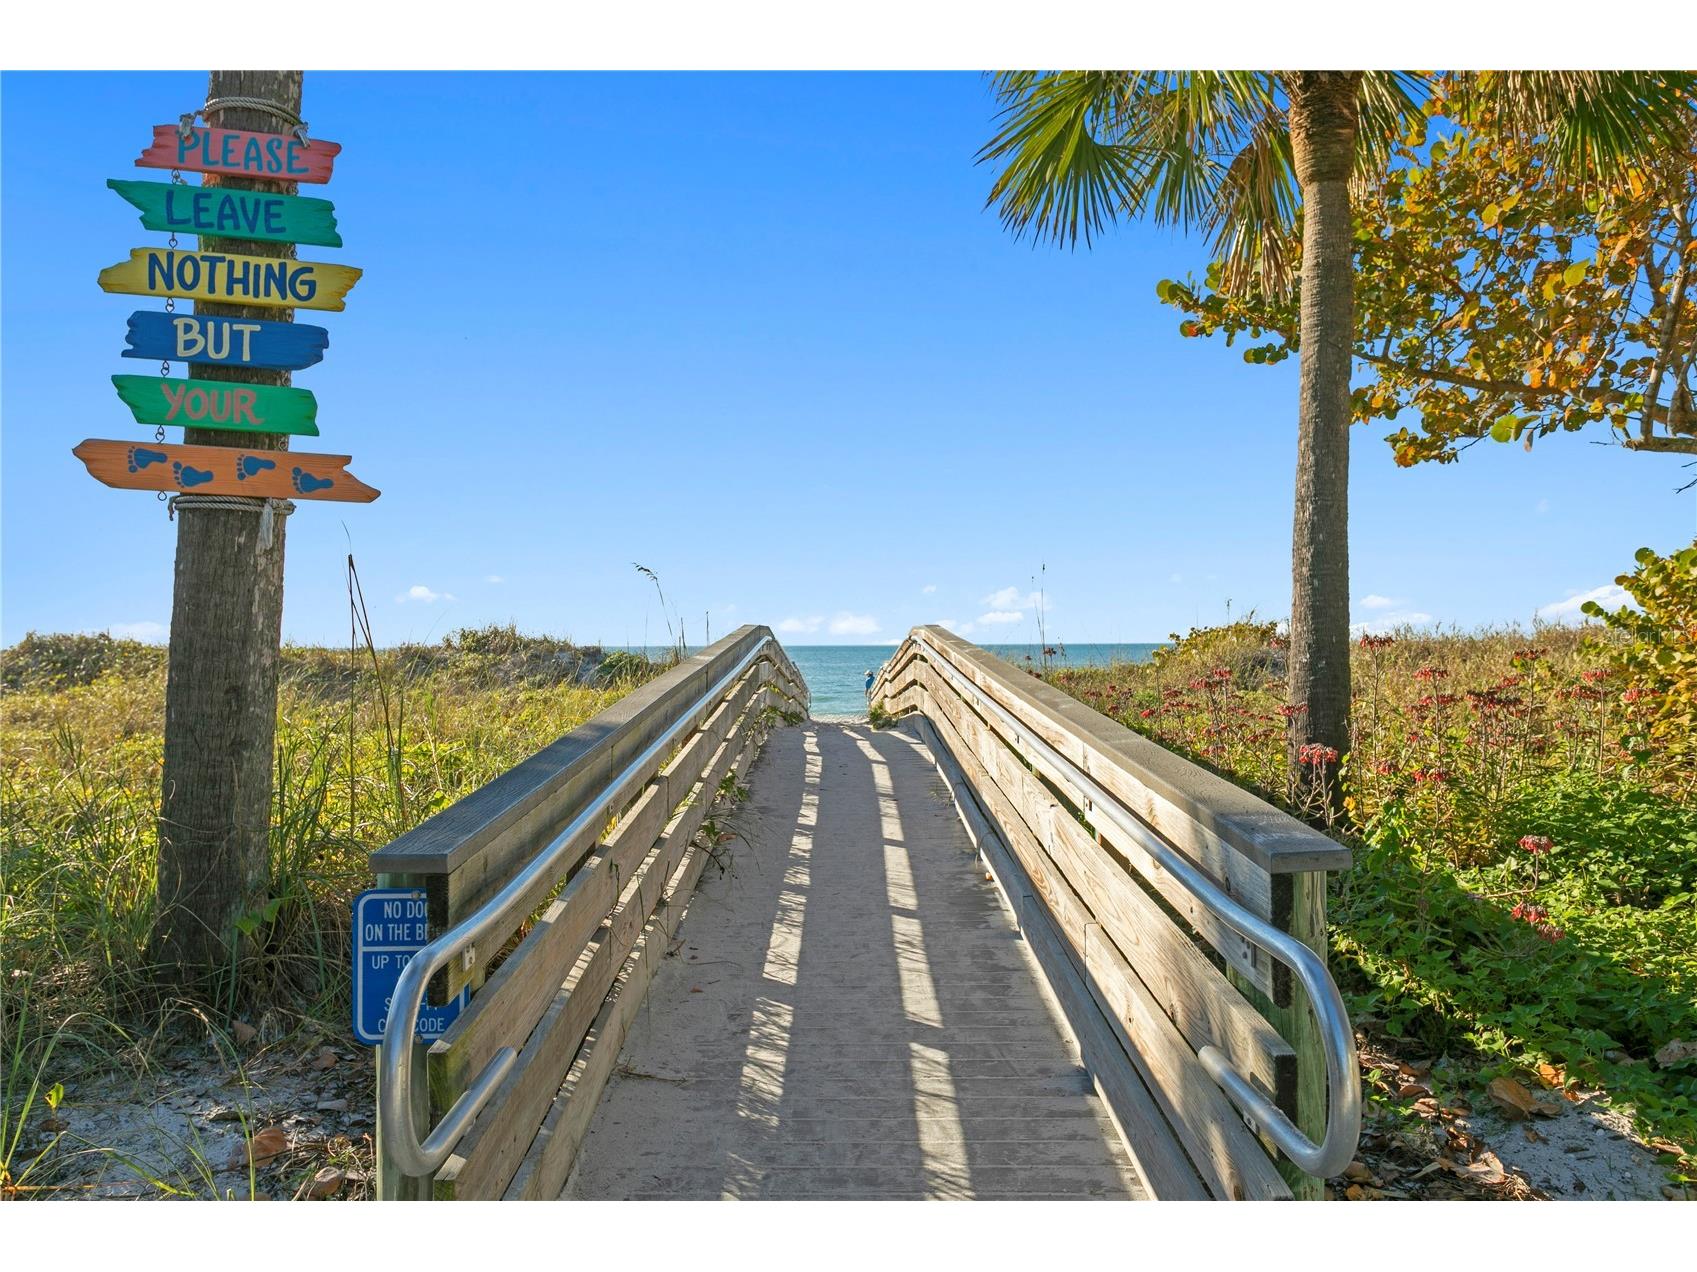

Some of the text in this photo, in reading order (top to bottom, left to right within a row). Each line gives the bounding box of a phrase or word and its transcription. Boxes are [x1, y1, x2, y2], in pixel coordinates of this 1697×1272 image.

[177, 131, 309, 174] PLEASE
[166, 190, 286, 233] LEAVE
[147, 252, 316, 301] NOTHING
[173, 318, 261, 361] BUT
[161, 383, 264, 425] YOUR
[384, 901, 401, 919] NO
[365, 923, 382, 941] ON
[387, 923, 411, 941] THE
[372, 955, 389, 969] UP
